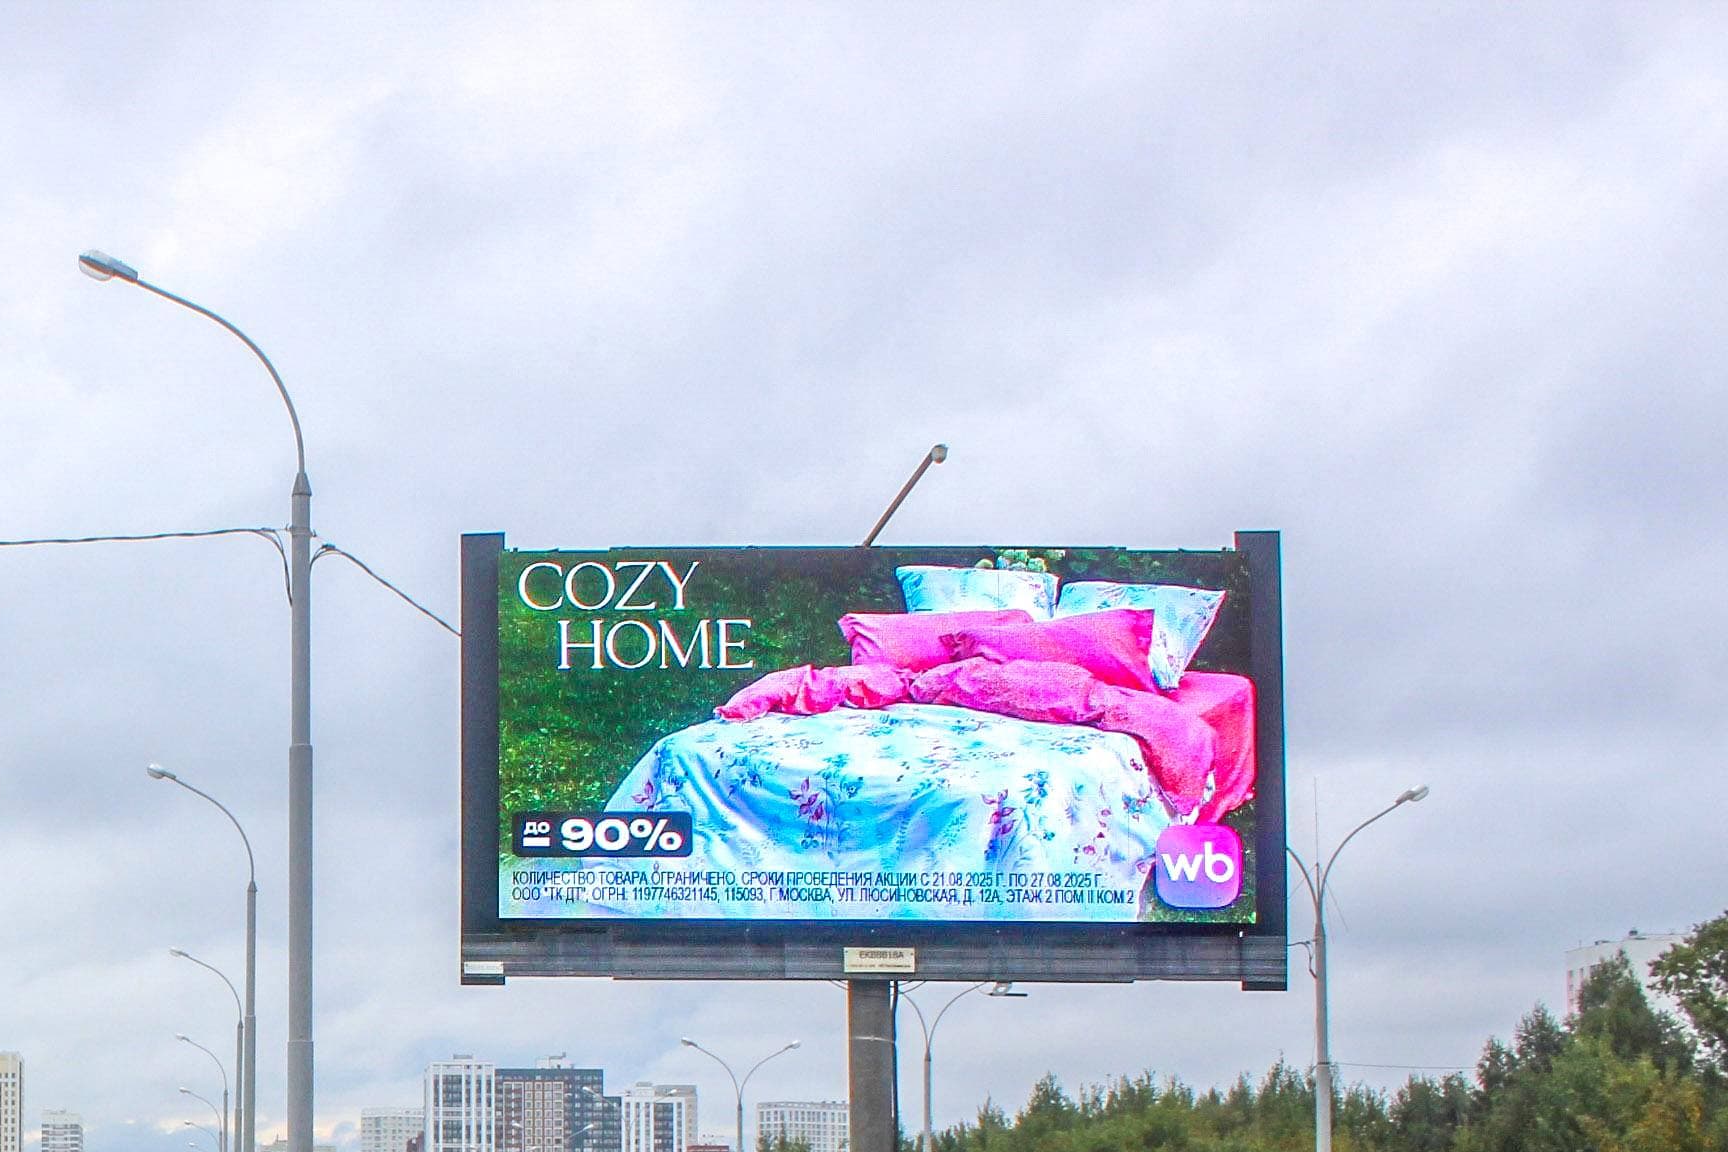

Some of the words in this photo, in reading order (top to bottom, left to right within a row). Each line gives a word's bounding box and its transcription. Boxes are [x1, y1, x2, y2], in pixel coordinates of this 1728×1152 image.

[518, 561, 700, 611] COZY
[557, 618, 754, 670] HOME
[512, 871, 595, 885] КОЛИЧЕСТВО
[598, 871, 647, 885] ТОВАРА
[650, 871, 738, 886] ОГРАНИЧЕНО.
[742, 871, 783, 886] СРОКИ
[787, 871, 871, 887] ПРОВЕДЕНИЯ
[875, 872, 917, 888] АКЦИИ
[920, 872, 929, 886] С
[933, 872, 992, 887] 21.08.2025
[1009, 873, 1028, 888] ПО
[1030, 873, 1092, 888] 27.08.2025
[1161, 841, 1234, 883] wb
[512, 887, 540, 901] ООО
[633, 887, 720, 903] 1197746321145,
[725, 887, 766, 903] 115093,
[860, 888, 961, 904] ЛЮСИНОВСКАЯ,
[1007, 889, 1041, 903] ЭТАЖ
[1045, 889, 1052, 903] 2
[1055, 889, 1084, 903] ПОМ
[1097, 889, 1123, 904] КОМ
[1126, 889, 1134, 904] 2
